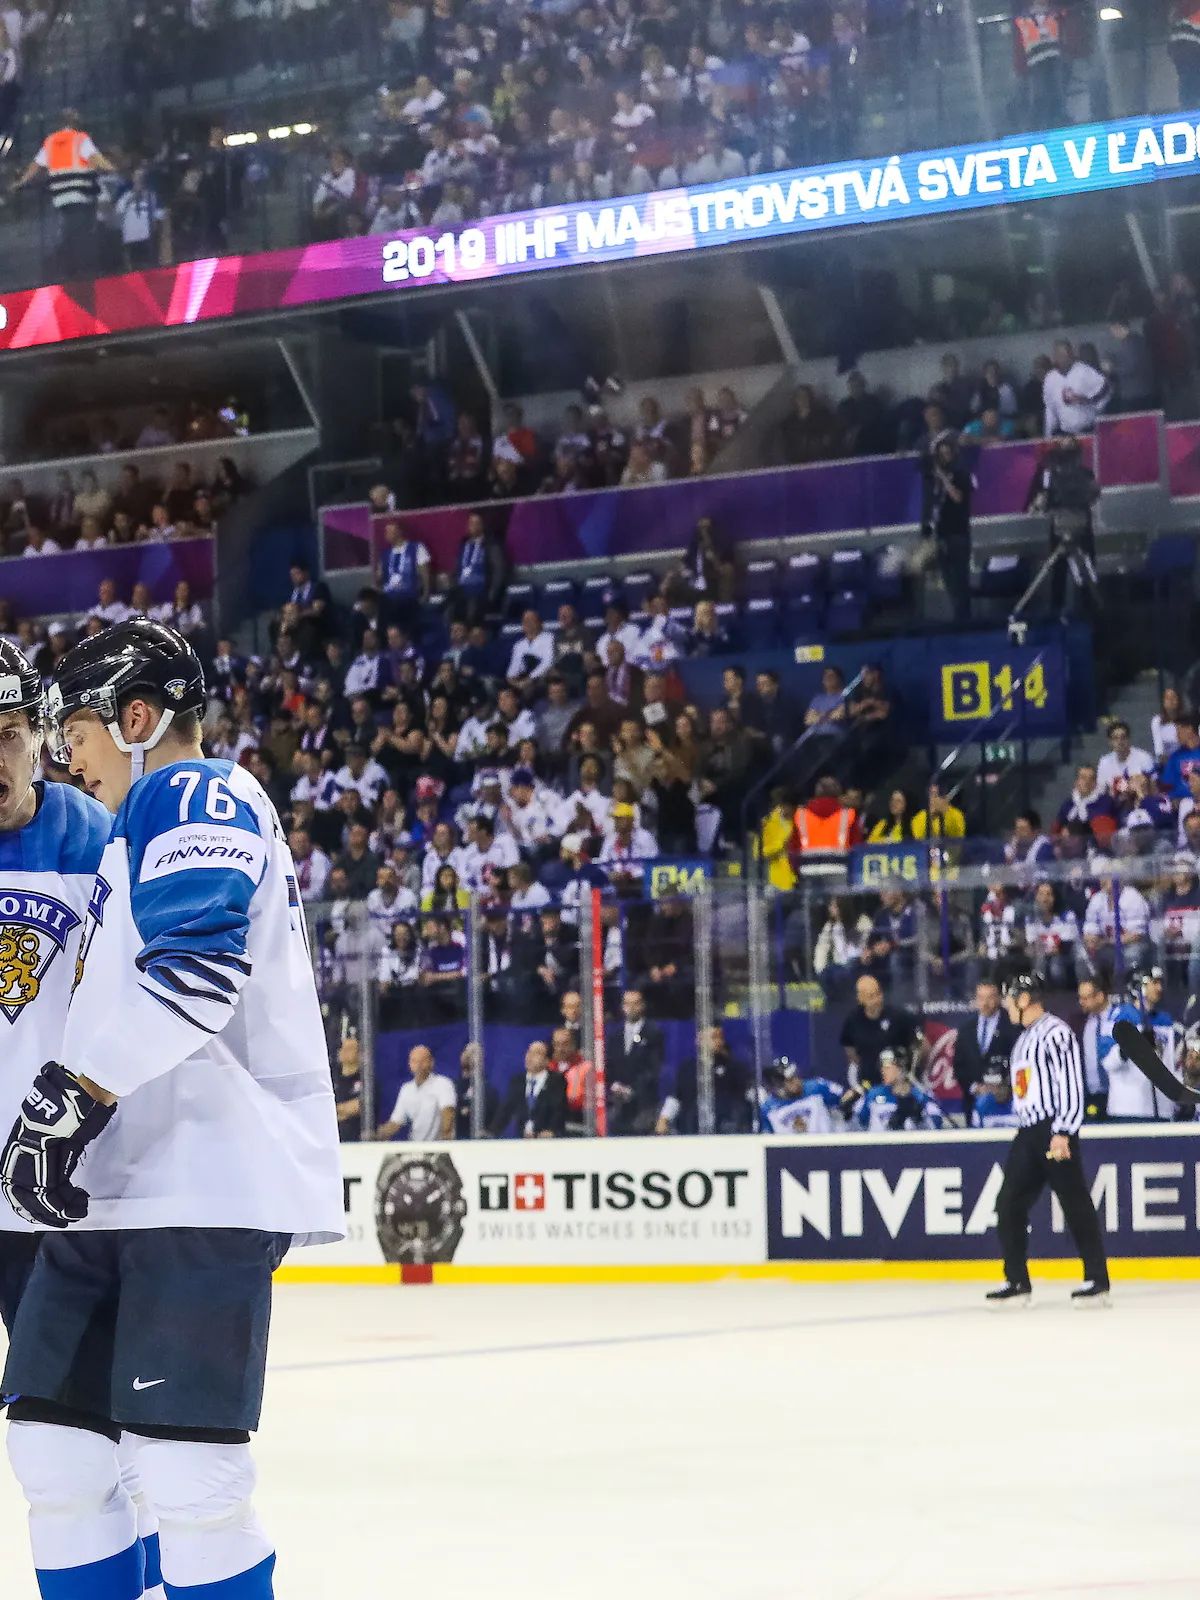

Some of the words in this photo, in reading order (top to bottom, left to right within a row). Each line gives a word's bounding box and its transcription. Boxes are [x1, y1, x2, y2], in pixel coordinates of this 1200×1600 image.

[382, 229, 486, 282] 2019
[494, 214, 568, 266] IIHF
[576, 155, 910, 254] MAJSTROVSTVÁ
[918, 144, 1057, 201] SVETA
[1064, 136, 1097, 179] V
[1108, 121, 1200, 174] ĽAD
[169, 771, 237, 823] 76
[178, 834, 208, 844] FLYING
[154, 845, 254, 868] FINNAIR
[552, 1170, 748, 1211] TISSOT
[478, 1221, 536, 1240] SWISS
[545, 1220, 634, 1240] WATCHES
[643, 1220, 700, 1240] SINCE
